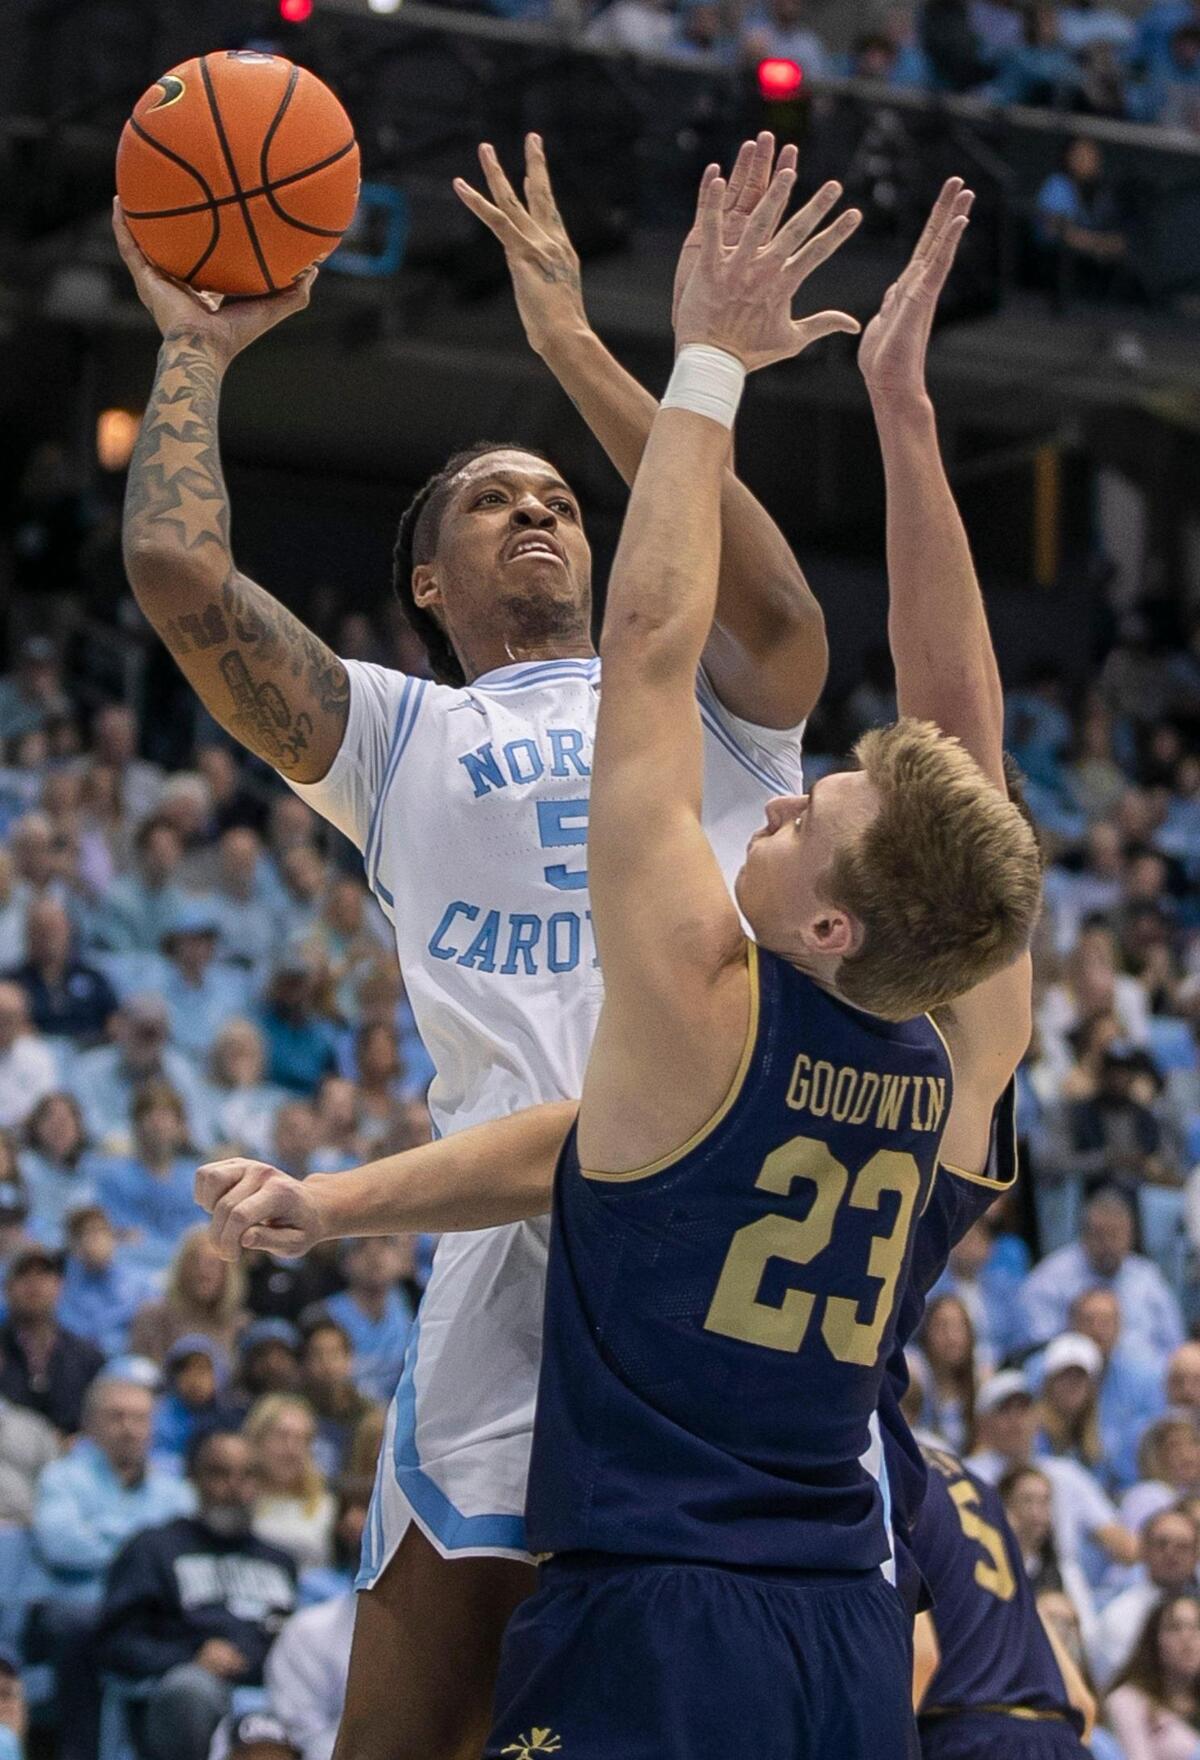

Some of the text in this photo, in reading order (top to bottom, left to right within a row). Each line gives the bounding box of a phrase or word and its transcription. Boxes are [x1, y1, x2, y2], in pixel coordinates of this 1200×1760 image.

[458, 728, 593, 798] NOR
[536, 799, 589, 890] 5
[428, 901, 600, 975] CARO
[785, 1053, 946, 1132] GOODWIN
[703, 1136, 921, 1367] 23
[947, 1479, 1017, 1602] 5
